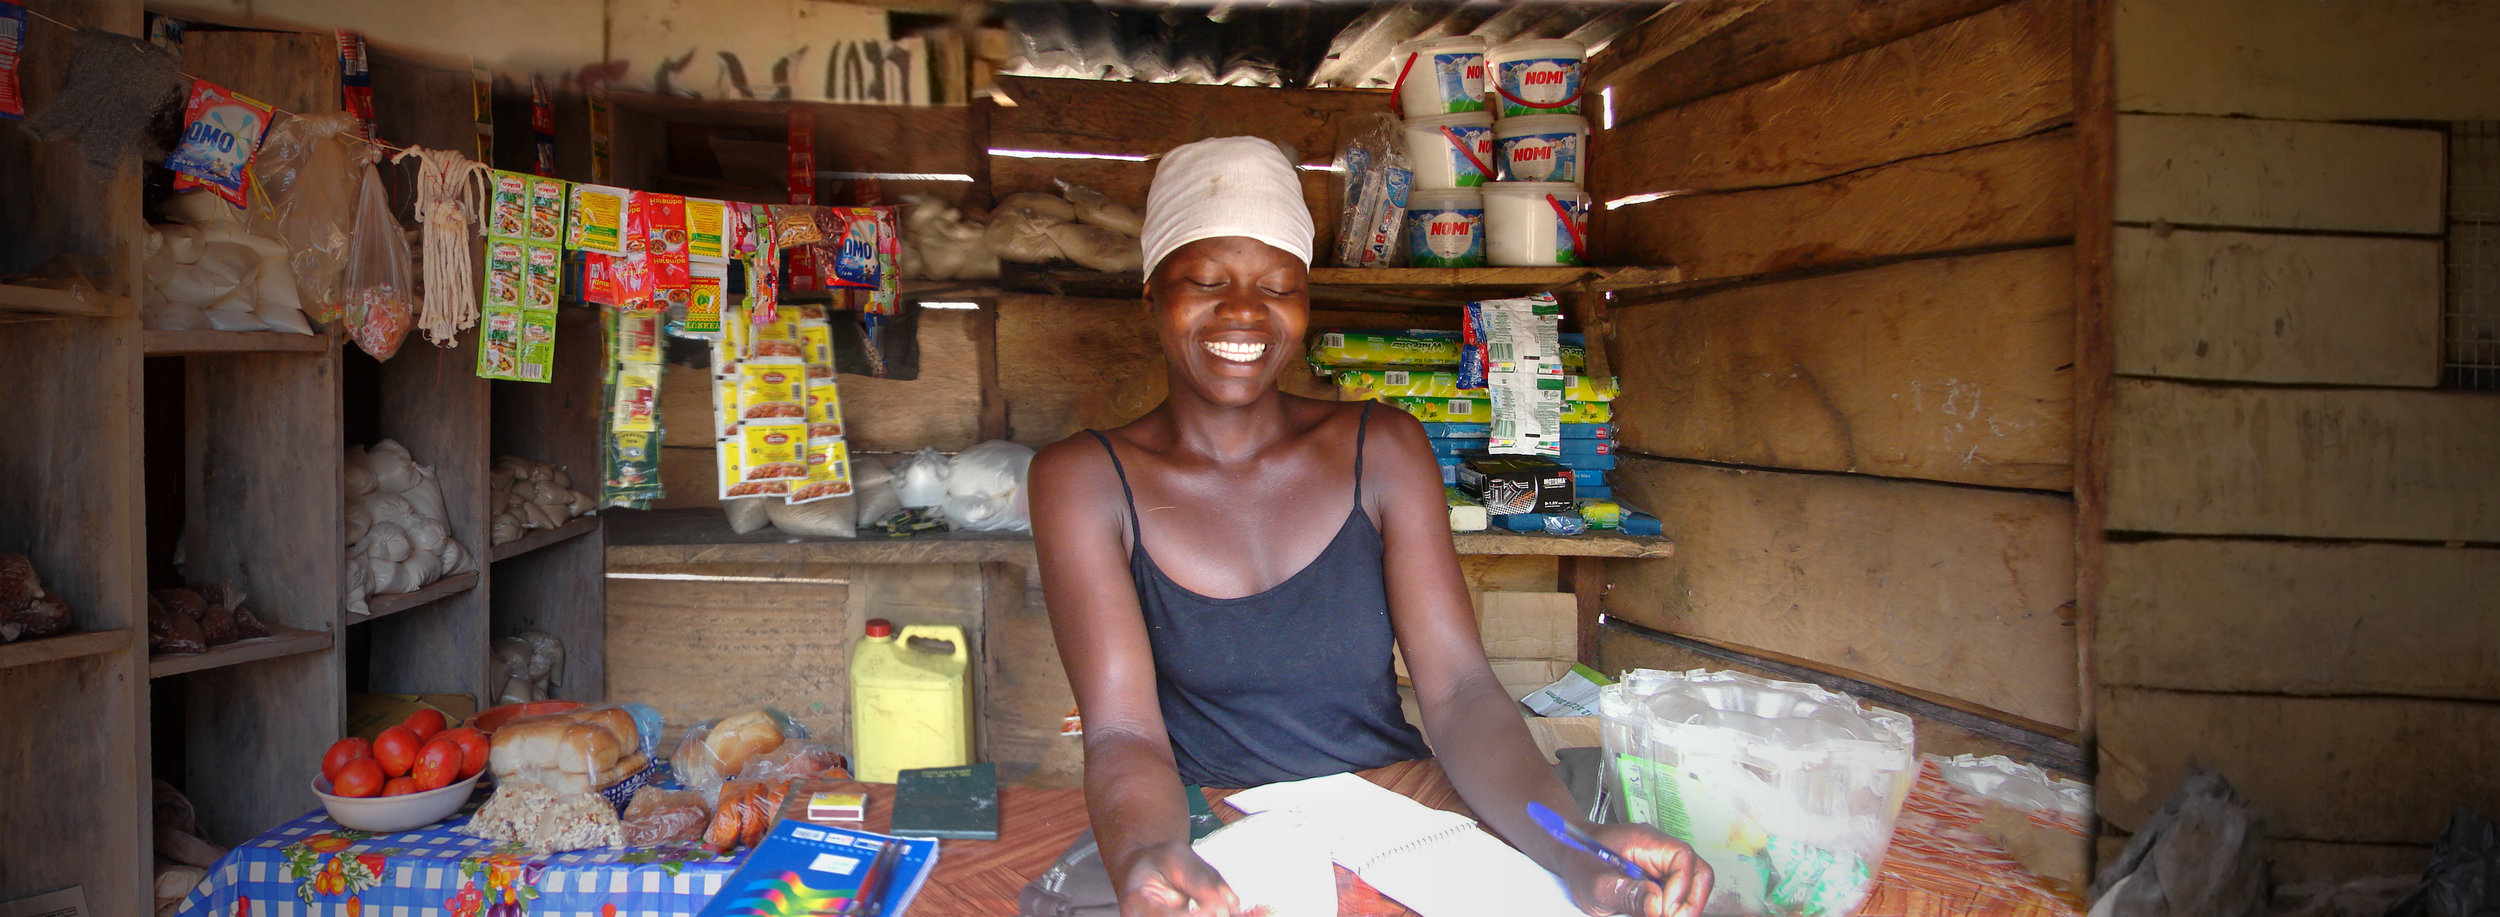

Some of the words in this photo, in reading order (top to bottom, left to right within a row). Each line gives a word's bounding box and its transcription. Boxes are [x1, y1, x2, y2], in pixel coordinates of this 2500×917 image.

[1525, 71, 1564, 86] NOMI
[187, 121, 235, 153] OMO
[1514, 146, 1552, 162] NOMI
[1430, 222, 1470, 236] NOMI
[844, 238, 872, 260] OMO
